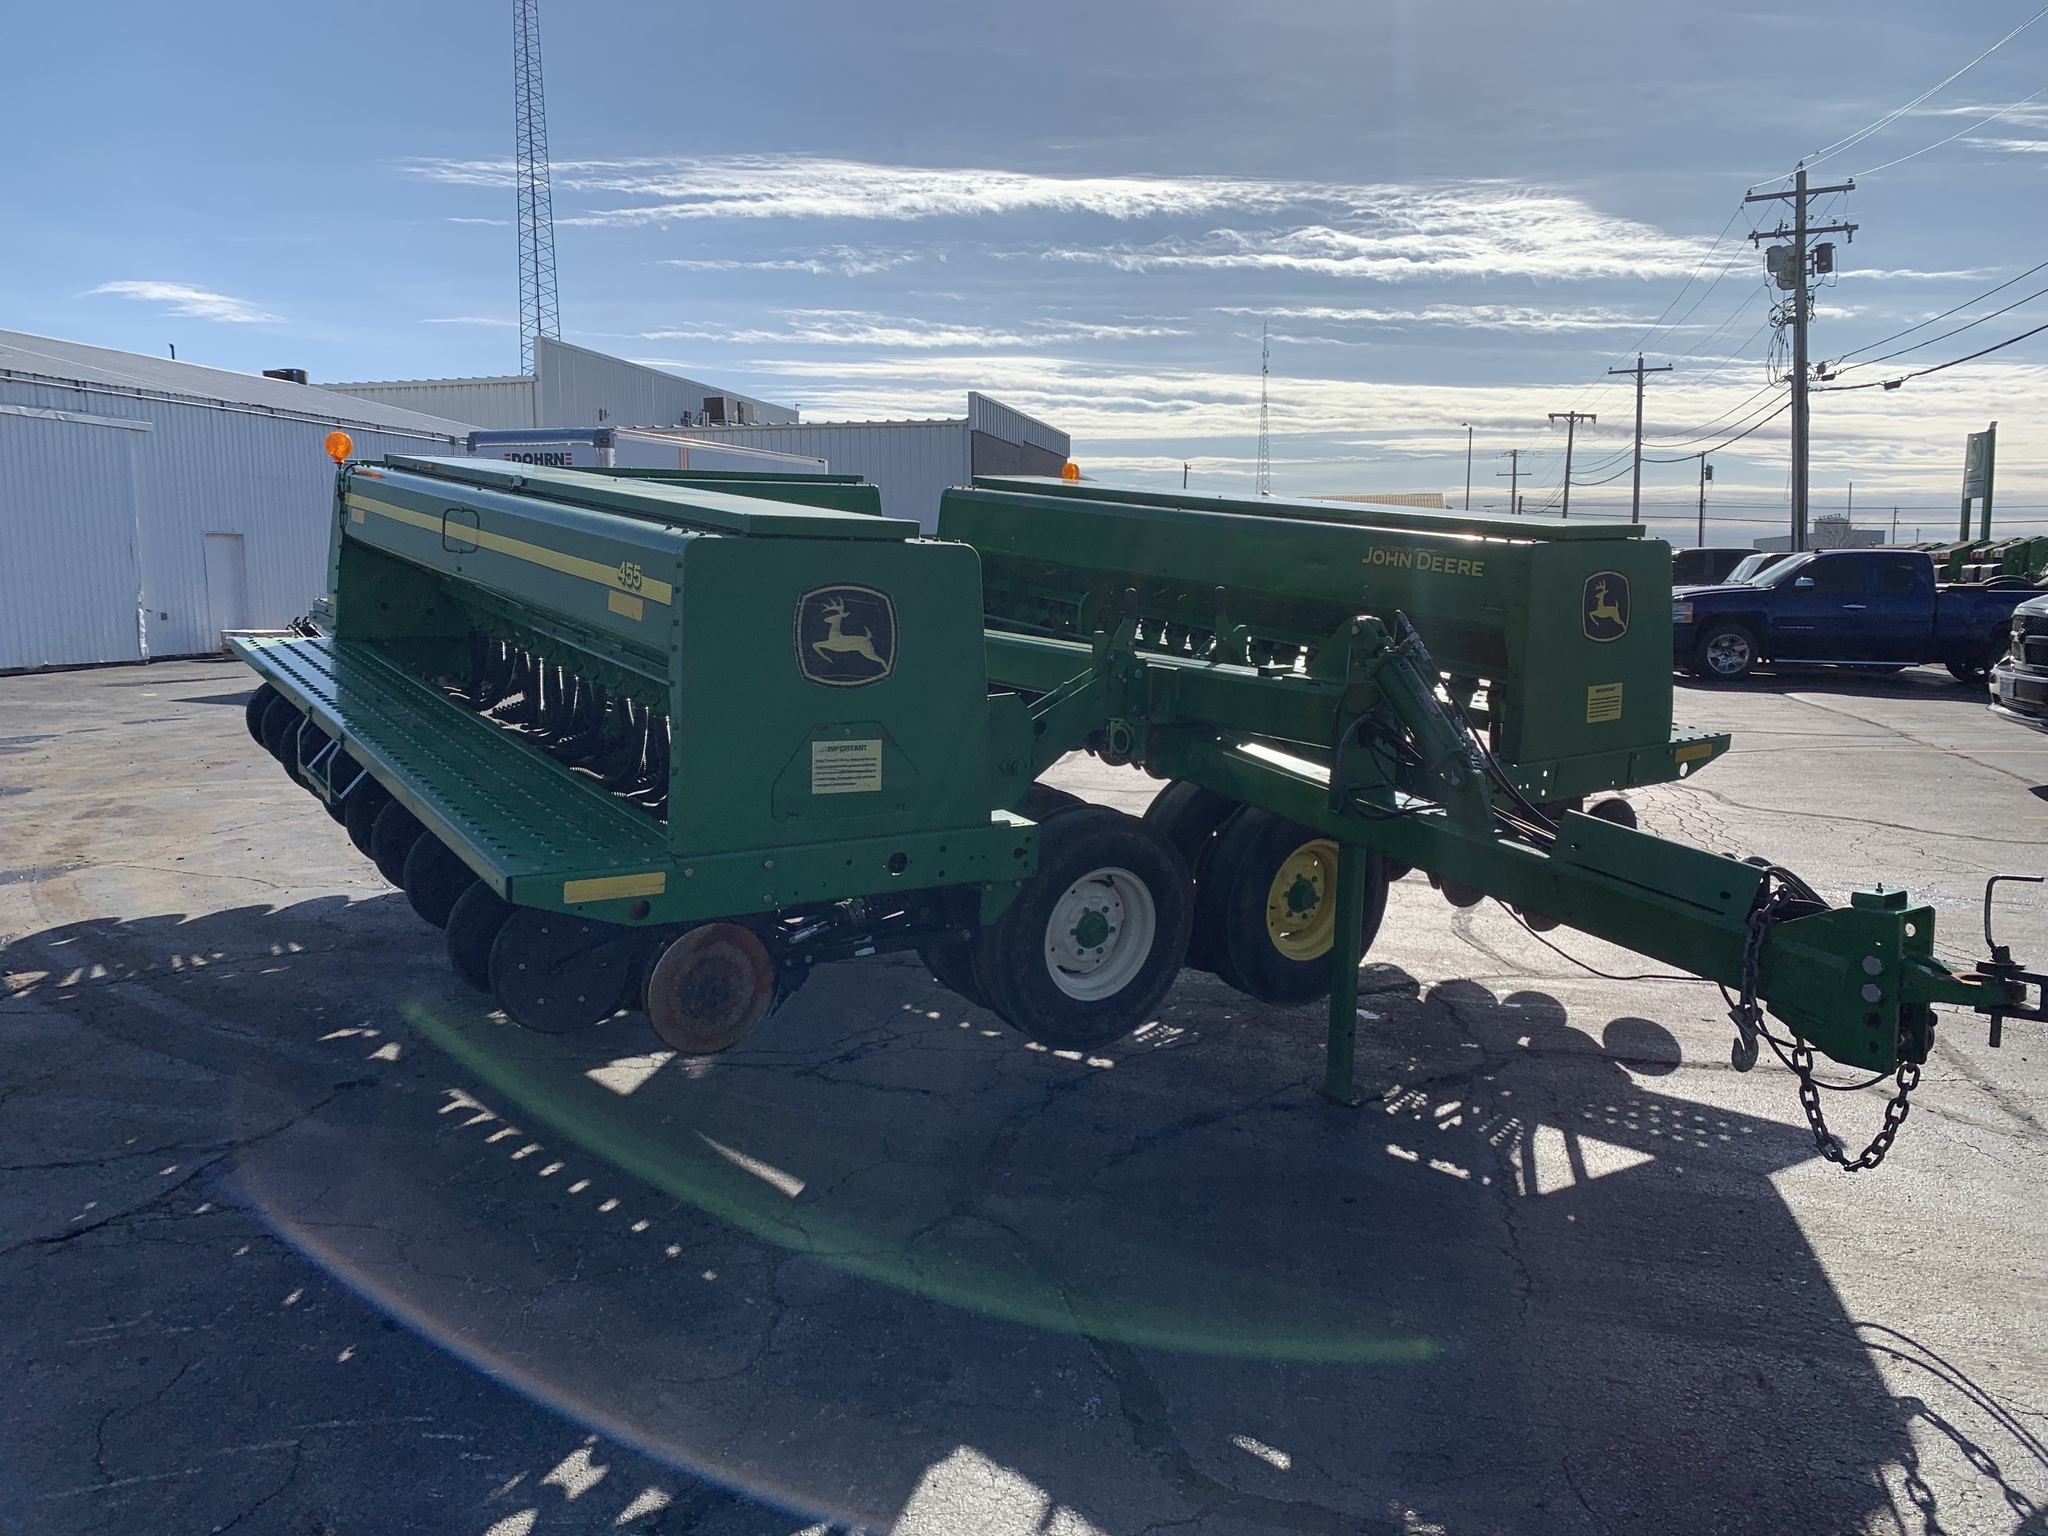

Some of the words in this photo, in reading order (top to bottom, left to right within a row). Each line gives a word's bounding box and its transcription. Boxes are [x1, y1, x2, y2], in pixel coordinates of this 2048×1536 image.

[511, 452, 565, 466] DOHRN
[1361, 546, 1413, 569] JOHN
[1416, 551, 1485, 577] DEERE
[617, 560, 643, 591] 455
[827, 744, 868, 753] IMPORTANT
